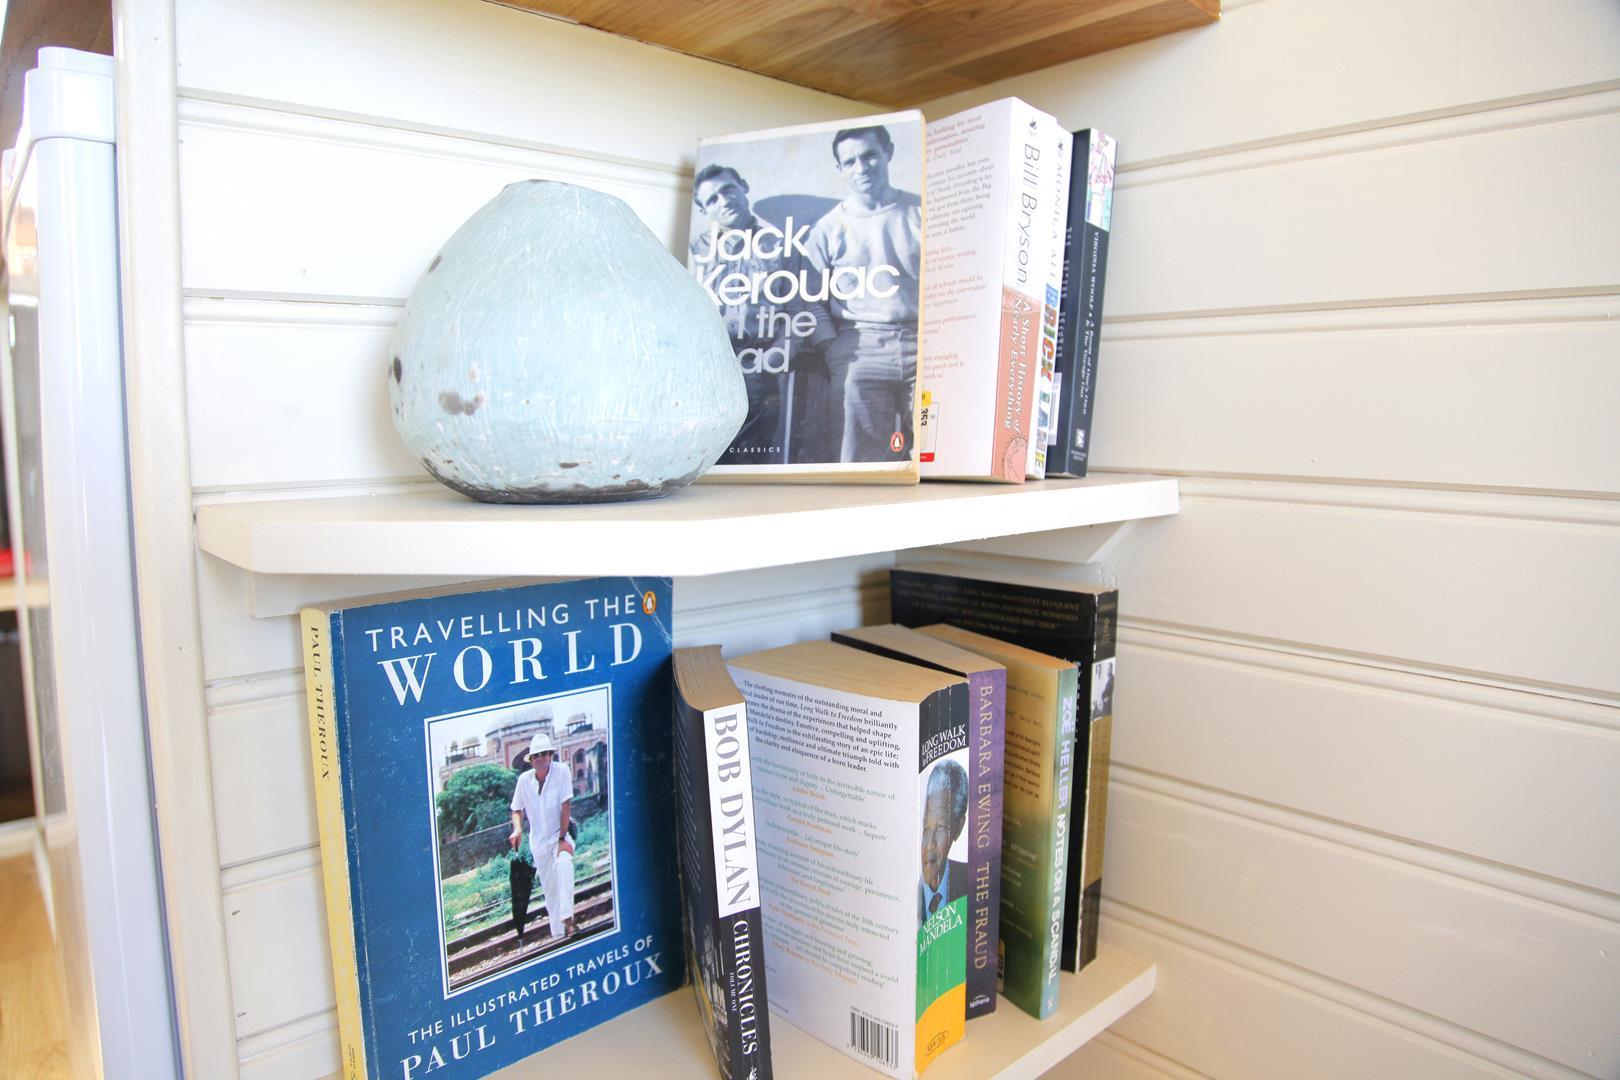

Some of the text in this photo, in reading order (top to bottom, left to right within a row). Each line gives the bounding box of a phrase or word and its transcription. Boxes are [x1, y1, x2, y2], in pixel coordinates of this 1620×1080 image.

[1017, 143, 1040, 284] Bill Bryson
[694, 216, 810, 263] Jack
[697, 264, 900, 306] Kerouac
[756, 306, 817, 338] the
[1041, 283, 1059, 382] BRICK
[1004, 298, 1022, 429] Nearly Everything
[1012, 300, 1032, 432] A Short History of
[729, 446, 781, 454] CLASSICS
[365, 594, 636, 652] TRAVELLING THE
[377, 622, 643, 706] WORLD
[311, 626, 330, 780] PAUL THEROUX
[800, 703, 813, 713] Long
[815, 707, 829, 715] Walk
[837, 712, 862, 723] Freedom
[864, 718, 897, 729] brilliantly
[802, 715, 834, 727] experiences
[849, 725, 870, 735] helped
[872, 730, 891, 740] shape
[814, 700, 848, 711] outstanding
[791, 748, 818, 759] eloquence
[832, 758, 846, 767] born
[795, 721, 819, 733] Emotive,
[821, 729, 854, 741] compelling
[868, 740, 900, 751] uplifting,
[801, 733, 835, 746] exhilarating
[836, 742, 850, 750] story
[869, 749, 883, 757] epic
[885, 751, 898, 760] life;
[817, 746, 841, 755] ultimate
[842, 752, 867, 763] triumph
[868, 758, 882, 766] told
[922, 724, 966, 756] LONG WALK
[927, 736, 966, 762] FREEDOM
[714, 712, 751, 906] BOB DYLAN
[974, 685, 993, 970] BARBARA EWING THE FRAUD
[1048, 696, 1075, 986] ZOË HELLER NOTES ON A SCANDAL
[919, 902, 963, 957] NELSON MANDELA
[407, 935, 654, 1045] THE ILLUSTRATED TRAVELS OF
[733, 920, 758, 1056] CHRONICLES
[969, 997, 990, 1009] sphere
[400, 1024, 496, 1080] PAUL
[509, 952, 665, 1036] THEROUX
